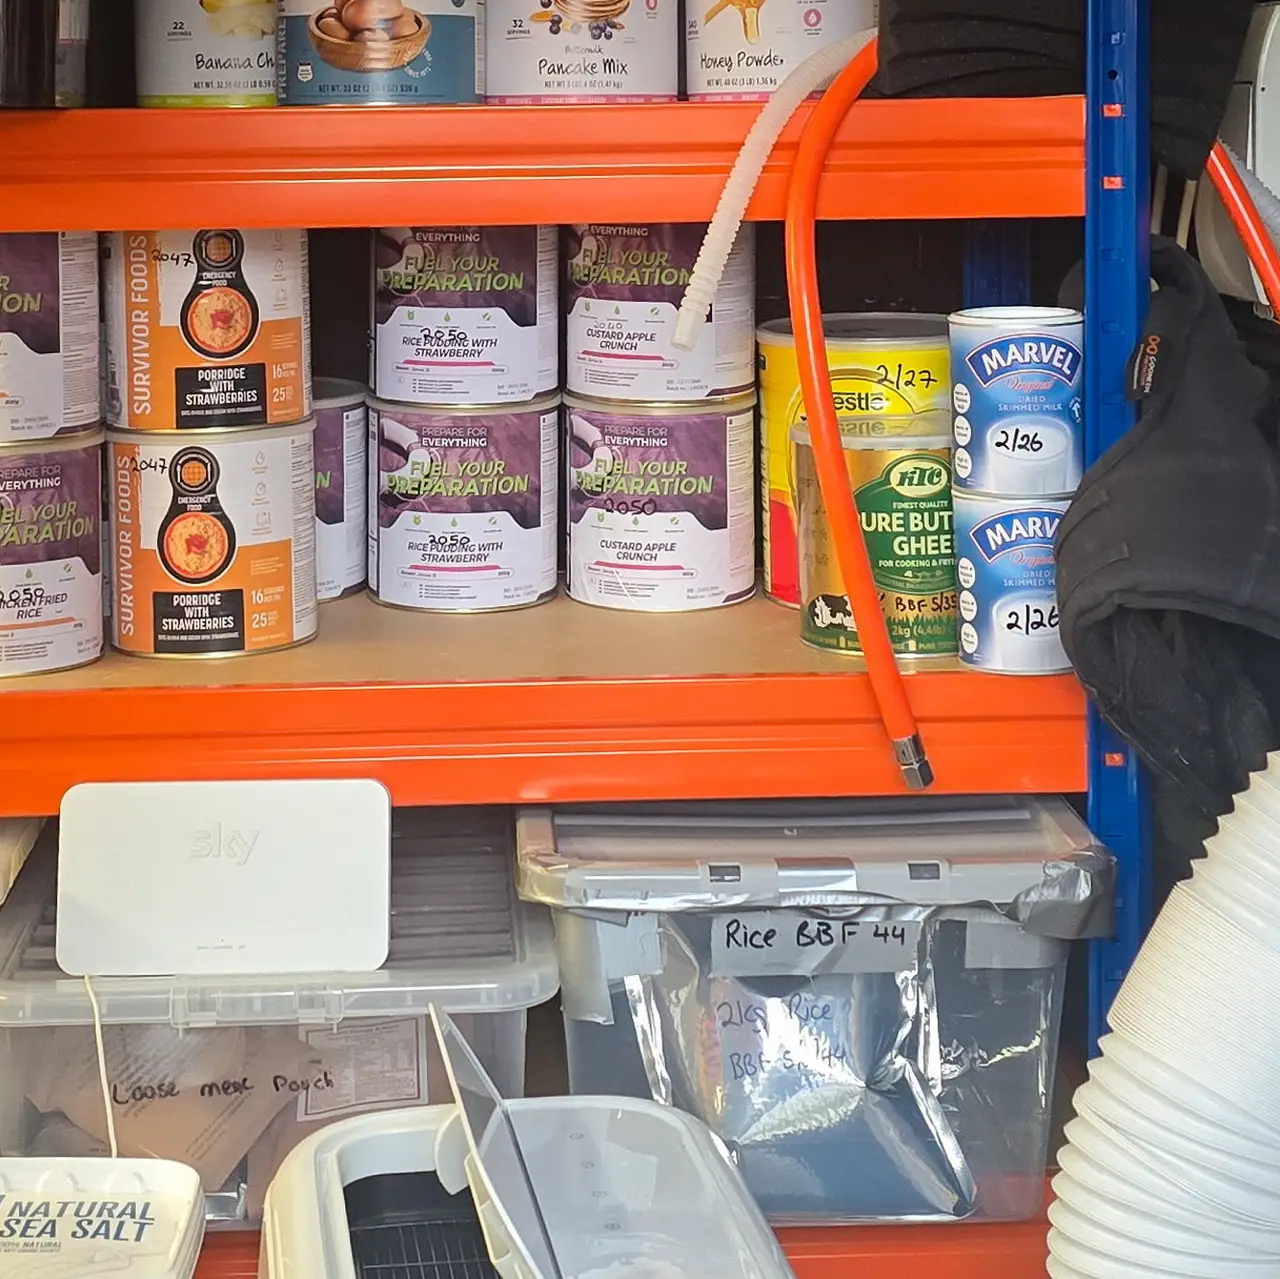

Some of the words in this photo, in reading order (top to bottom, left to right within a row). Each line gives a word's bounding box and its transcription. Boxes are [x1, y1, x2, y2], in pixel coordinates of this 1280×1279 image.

[172, 21, 185, 30] 22
[196, 54, 252, 70] Banana
[538, 58, 598, 75] Pancake
[602, 58, 628, 75] Mix
[700, 53, 733, 72] Honey
[129, 236, 149, 304] FOODS
[450, 256, 499, 271] YOUR
[586, 328, 623, 340] CUSTARD
[625, 332, 657, 341] APPLE
[424, 338, 469, 348] PUDDING
[471, 338, 497, 348] WITH
[600, 340, 638, 351] CRUNCH
[414, 349, 483, 359] STRAWBERRY
[981, 342, 1073, 376] MARVEL
[132, 309, 152, 416] SURVIVOR
[198, 368, 245, 382] PORRIDGE
[876, 363, 937, 388] 2/27
[186, 391, 257, 406] STRAWBERRIES
[422, 437, 487, 448] EVERYTHING
[995, 428, 1043, 452] 2/26
[38, 465, 61, 476] FOR
[457, 461, 505, 475] YOUR
[639, 461, 686, 475] YOUR
[117, 455, 131, 524] FOODS
[387, 475, 529, 496] PREPARATION
[919, 500, 948, 509] QUALITY
[985, 516, 1060, 551] MARV
[430, 542, 475, 553] PUDDING
[477, 541, 503, 552] WITH
[601, 540, 640, 552] CUSTARD
[644, 542, 676, 553] APPLE
[893, 535, 952, 556] GHEE
[421, 552, 490, 563] STRAWBERRY
[617, 551, 657, 562] CRUNCH
[895, 559, 931, 568] COOKING
[120, 531, 134, 636] SURVIVOR
[1004, 578, 1045, 587] SKIMMED
[39, 592, 68, 607] FRIED
[173, 594, 221, 606] PORRIDGE
[895, 599, 927, 612] BBF
[17, 608, 43, 619] RICE
[185, 607, 209, 618] WITH
[1006, 604, 1059, 635] 2/26
[162, 616, 234, 631] STRAWBERRIES
[189, 822, 260, 865] sky
[725, 918, 777, 949] Rice
[873, 924, 905, 946] 44
[788, 993, 831, 1021] Rice
[7, 1201, 156, 1222] NATURAL
[70, 1220, 154, 1242] SALT
